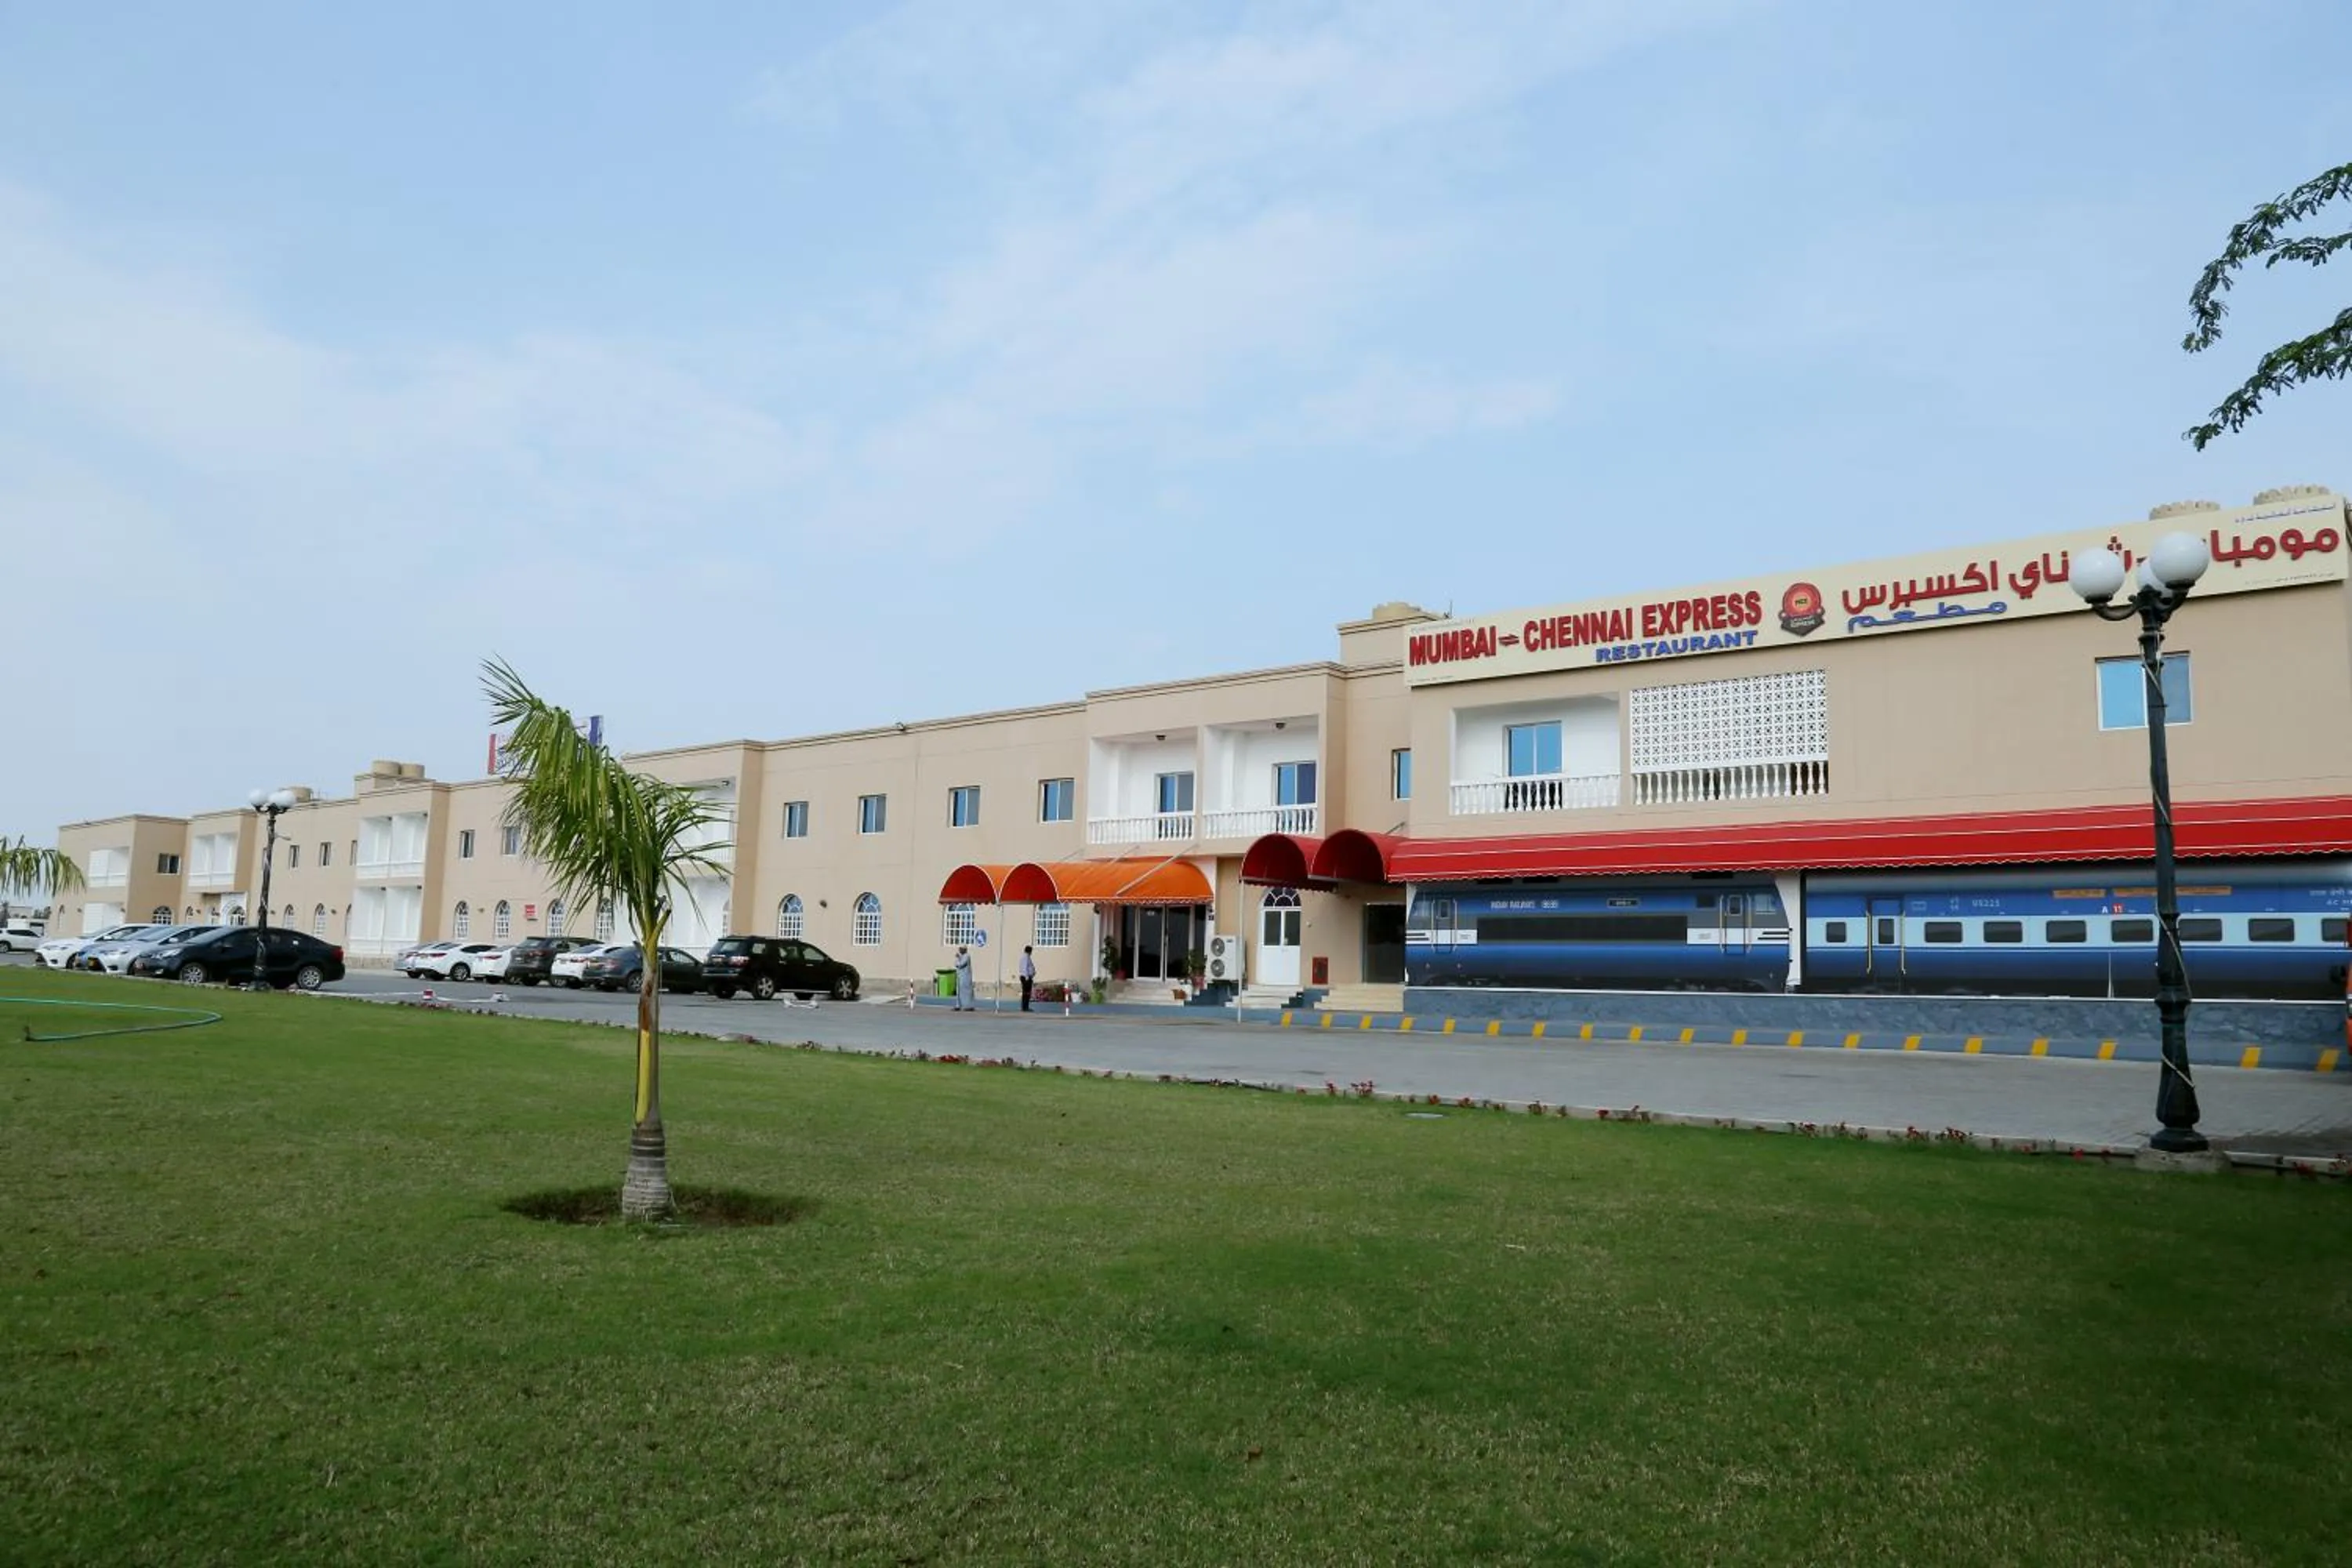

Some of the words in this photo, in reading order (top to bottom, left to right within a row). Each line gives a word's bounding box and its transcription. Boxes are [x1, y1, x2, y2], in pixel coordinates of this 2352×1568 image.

[2201, 528, 2339, 568] مومبا
[1842, 560, 1999, 615] اكسبرس
[1409, 626, 1497, 666] MUMBAI
[1523, 608, 1632, 652] CHENNAI
[1642, 590, 1762, 637] EXPRESS
[1848, 601, 2007, 633] مطعم
[1595, 630, 1759, 662] RESTAURANT
